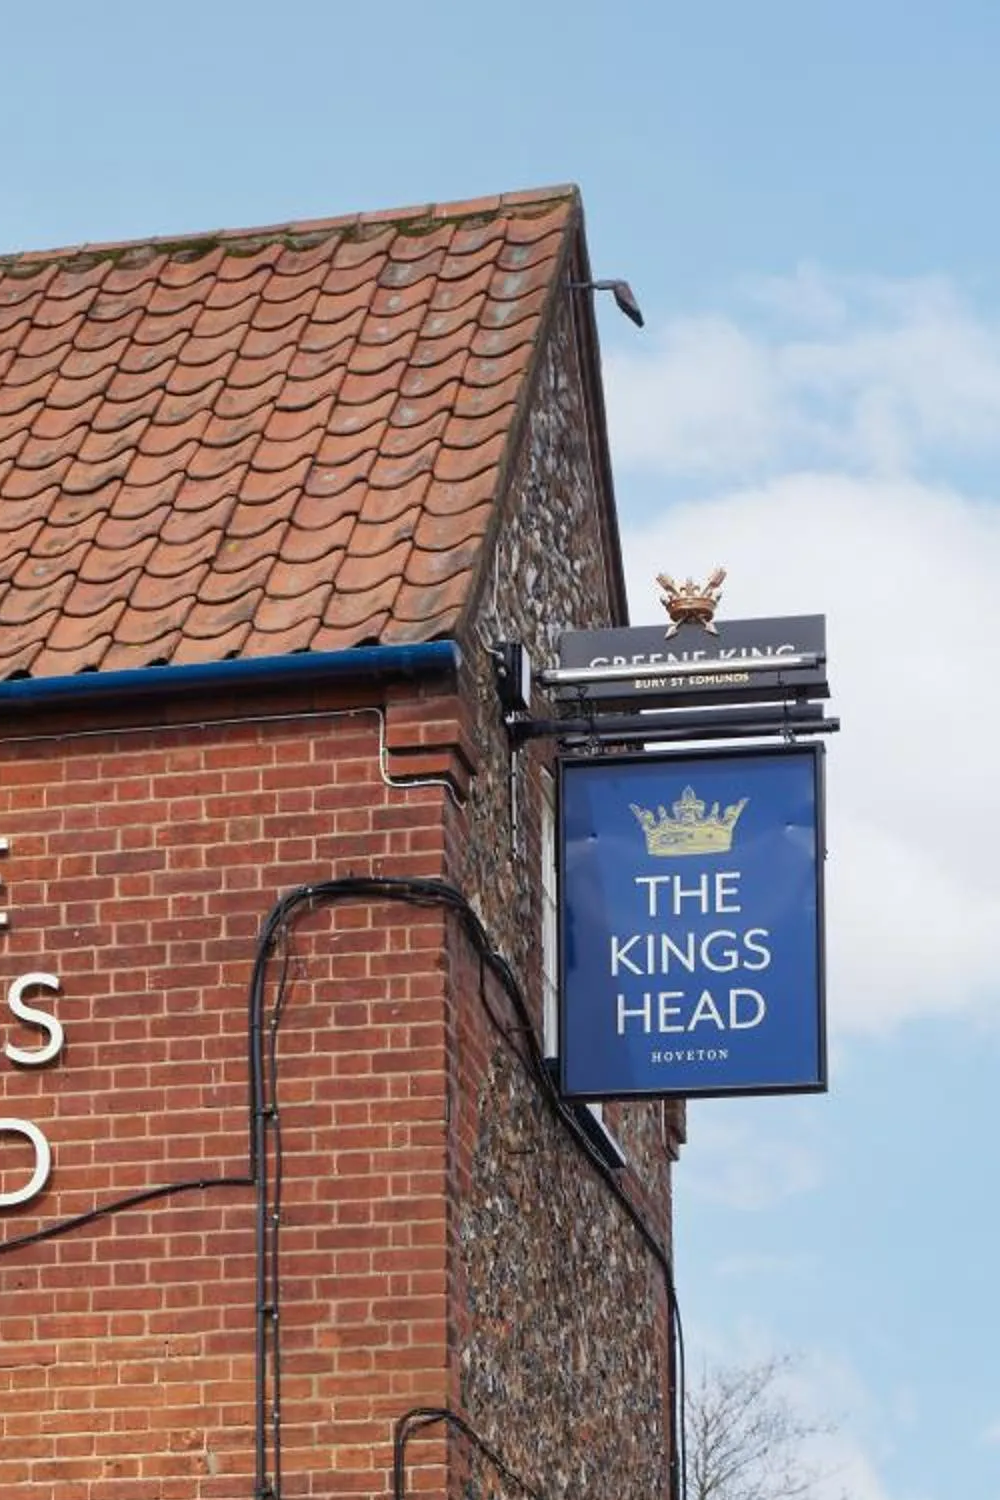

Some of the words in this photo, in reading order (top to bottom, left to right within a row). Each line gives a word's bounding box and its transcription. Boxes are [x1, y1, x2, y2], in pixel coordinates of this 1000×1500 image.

[634, 678, 667, 689] BURY
[671, 677, 685, 687] ST
[689, 672, 750, 685] EDMUNDS
[635, 871, 742, 917] THE
[610, 928, 772, 977] KINGS
[616, 988, 767, 1035] HEAD
[651, 1049, 730, 1063] HOVETON
